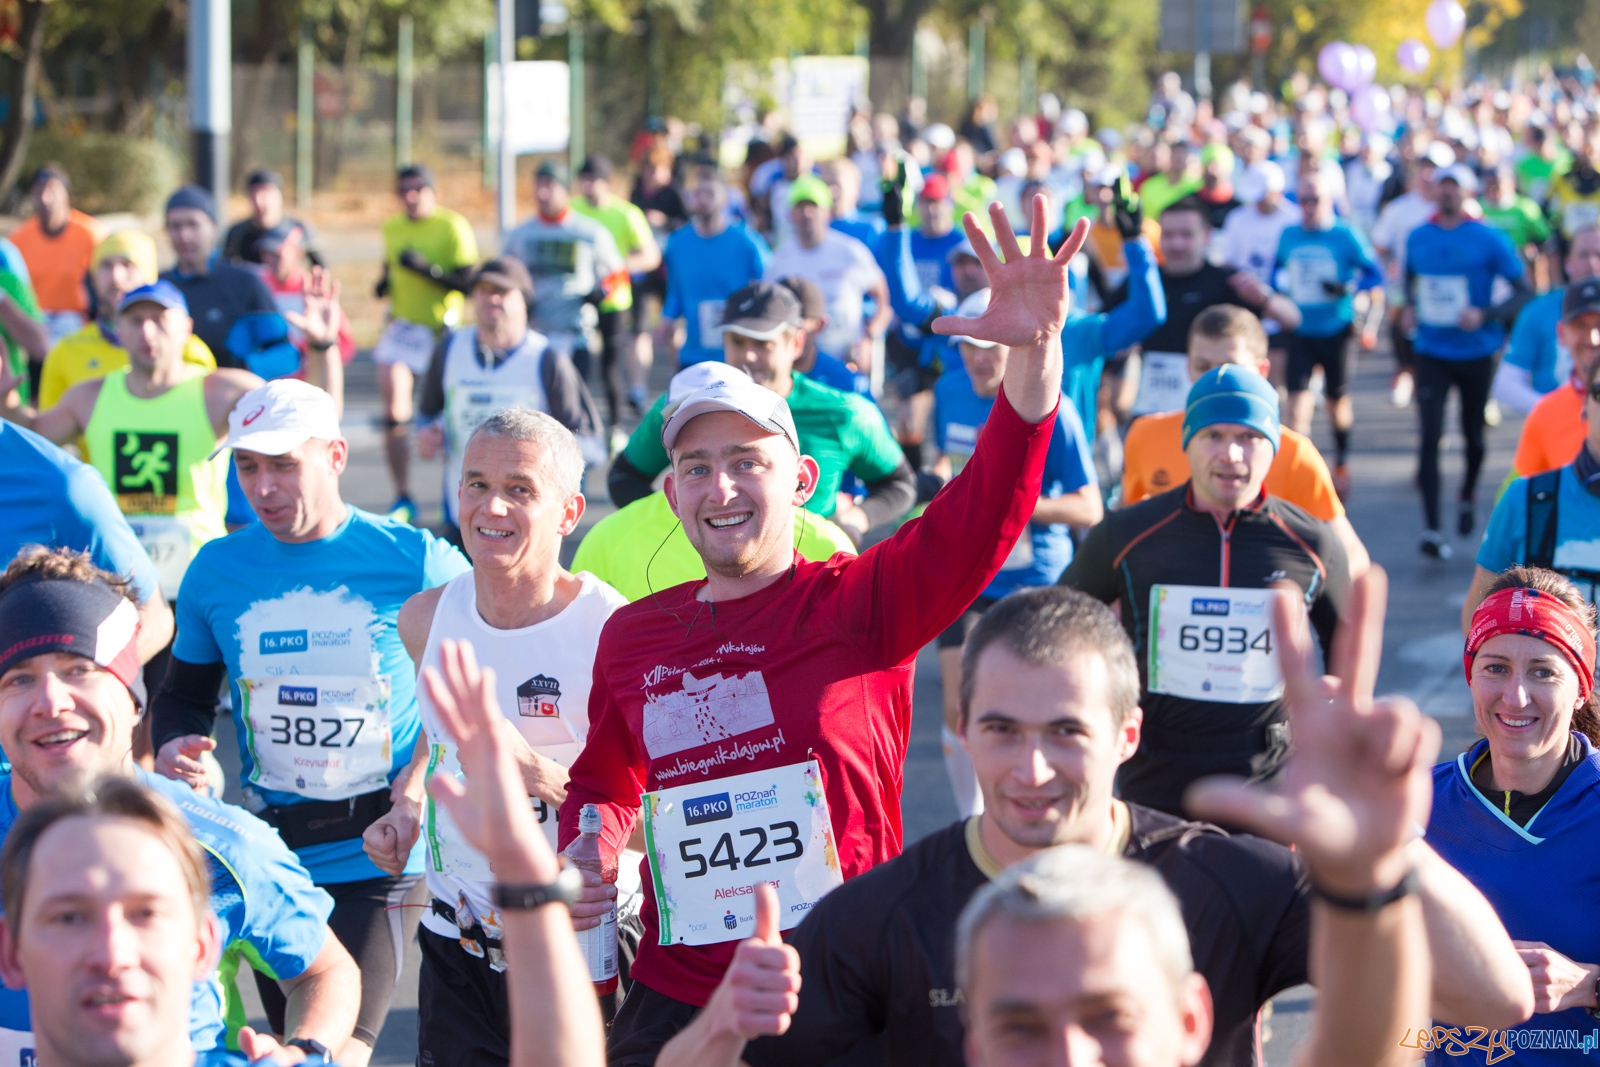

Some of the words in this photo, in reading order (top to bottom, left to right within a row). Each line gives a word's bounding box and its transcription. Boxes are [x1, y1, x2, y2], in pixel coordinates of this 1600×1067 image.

[280, 635, 304, 647] PKO
[312, 638, 351, 648] maraton
[1180, 624, 1272, 655] 6934
[531, 679, 558, 689] XXVII
[640, 664, 663, 690] XII
[293, 691, 315, 702] PKO
[270, 714, 365, 748] 3827
[655, 728, 786, 781] www.biegmikolajow.pl
[293, 757, 341, 768] Krzysztof
[703, 800, 728, 814] PKO
[736, 797, 778, 811] maraton
[181, 801, 256, 841] noname
[679, 820, 804, 879] 5423
[714, 879, 781, 900] Aleksaer
[739, 914, 755, 923] Bank
